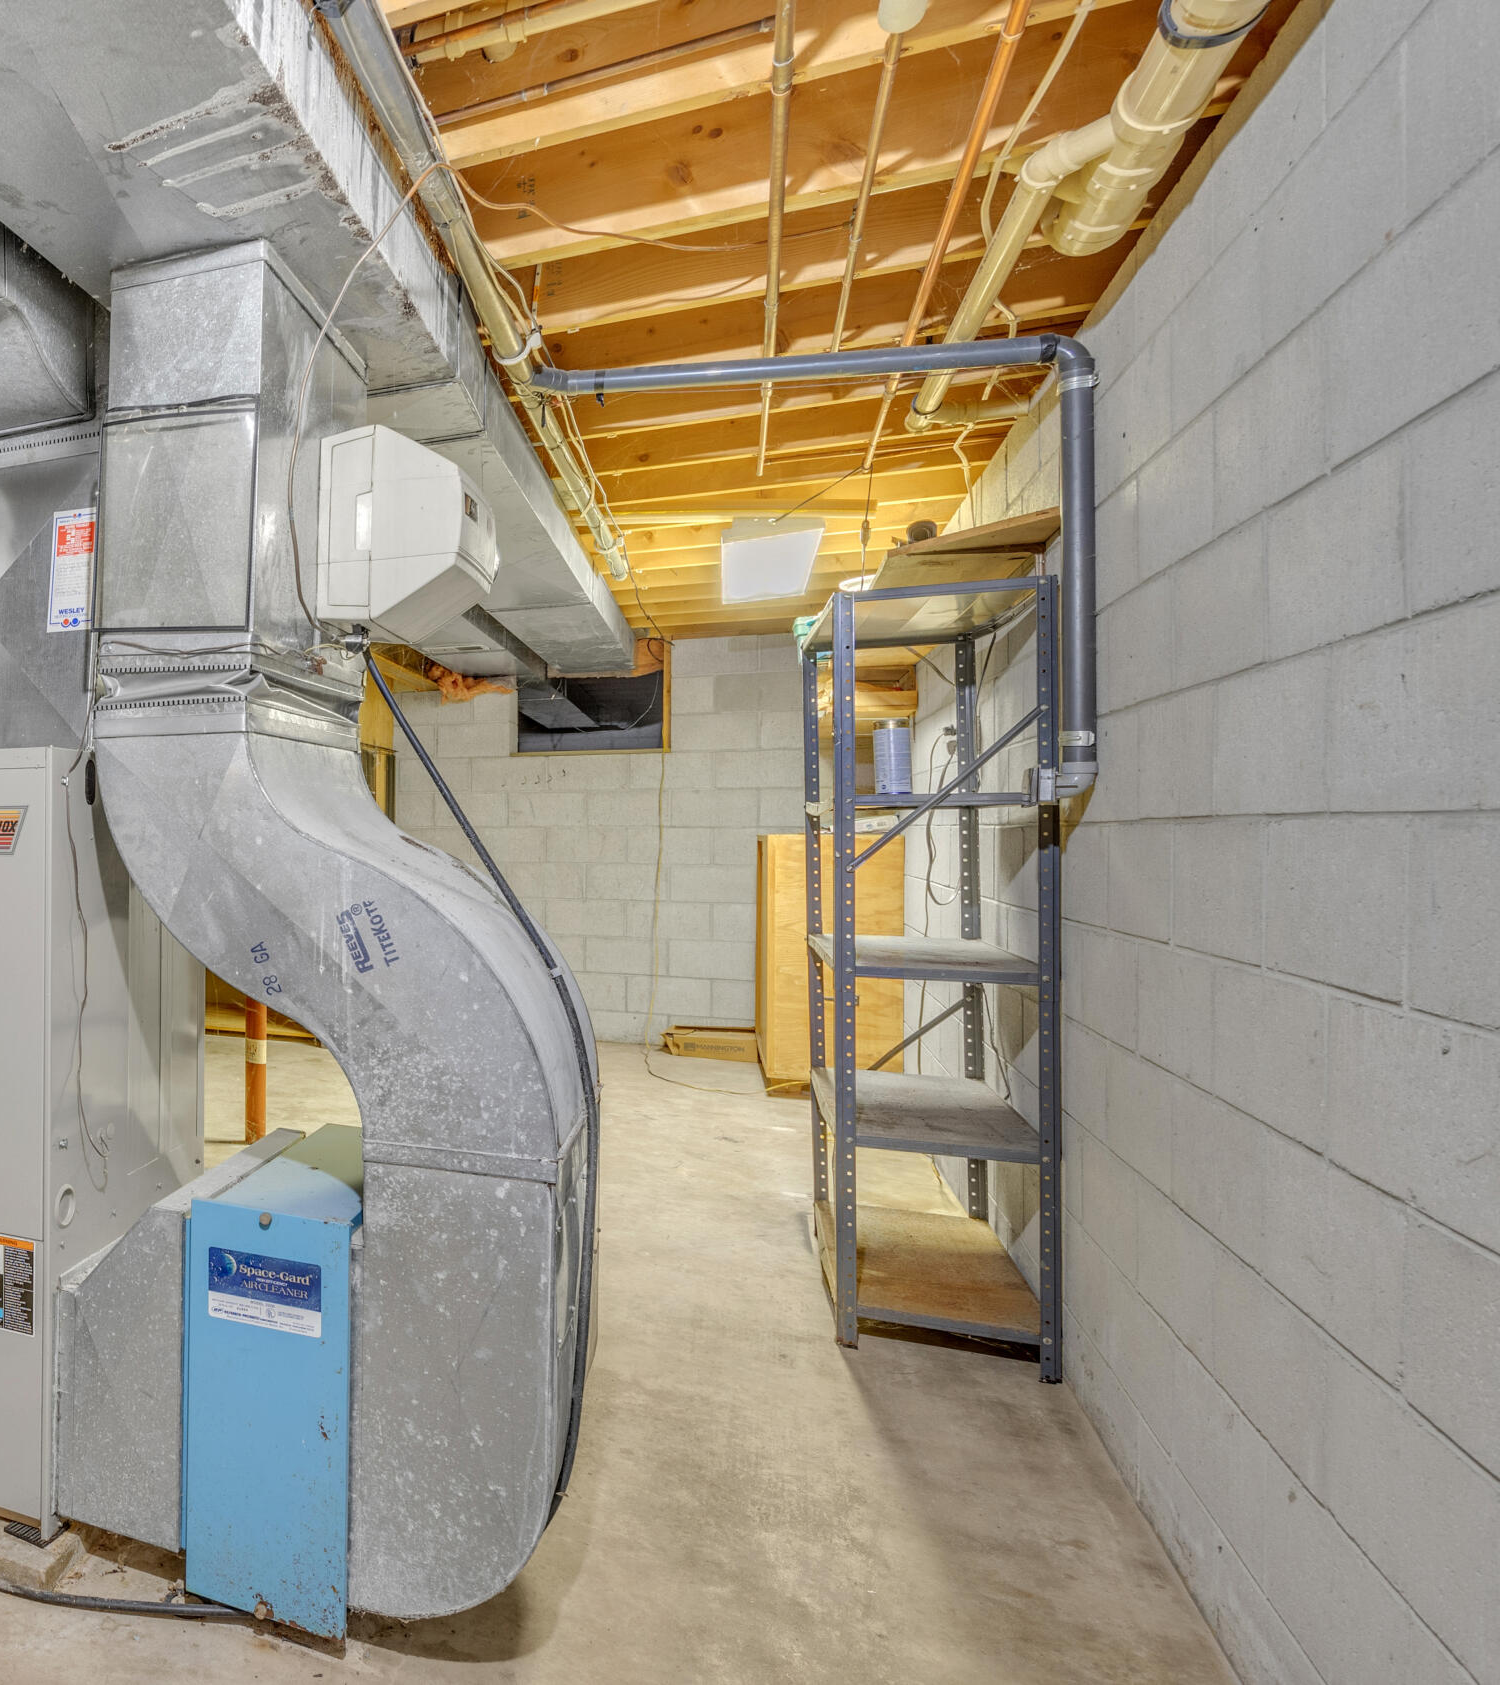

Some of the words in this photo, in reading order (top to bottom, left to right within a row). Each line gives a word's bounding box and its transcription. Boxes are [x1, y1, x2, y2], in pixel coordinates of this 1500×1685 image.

[250, 941, 270, 964] GA
[336, 910, 374, 974] REEVES
[263, 975, 282, 996] 28
[240, 1264, 310, 1286] Space-Gard
